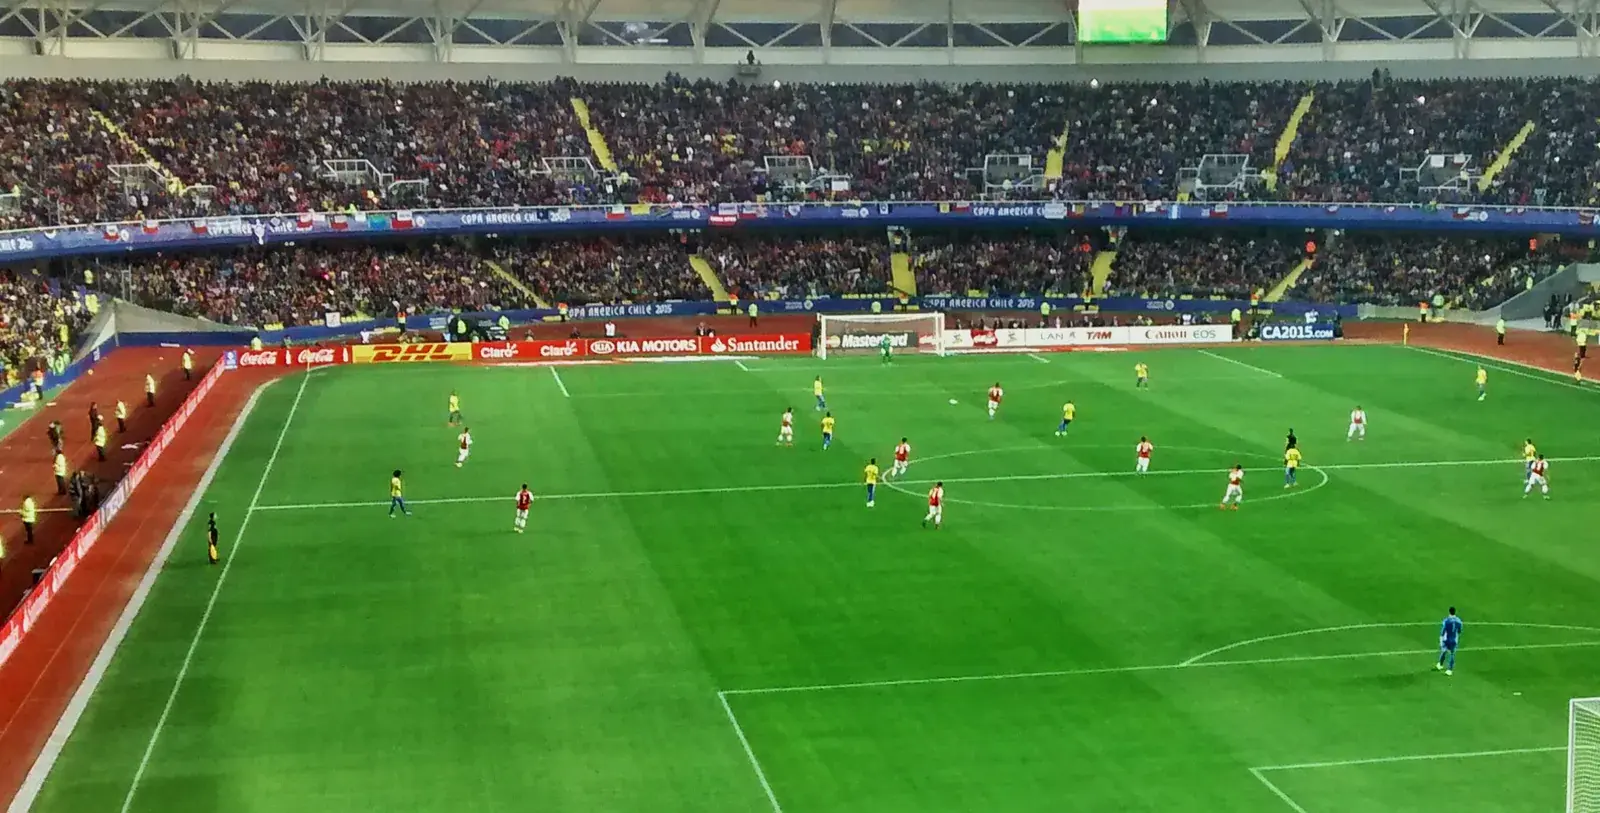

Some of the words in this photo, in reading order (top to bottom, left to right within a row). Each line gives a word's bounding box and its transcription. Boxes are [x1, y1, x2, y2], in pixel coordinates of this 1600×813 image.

[973, 207, 996, 217] COPA
[998, 206, 1034, 217] AMERICA
[461, 213, 484, 225] COPA
[486, 212, 522, 224] AMERICA
[949, 299, 987, 308] AMERICA
[989, 299, 1013, 308] CHILE
[1017, 299, 1036, 308] 2015
[568, 308, 586, 318] OPA
[588, 305, 626, 317] AMERICA
[627, 304, 652, 315] CHILE
[655, 304, 673, 314] 2015
[1086, 331, 1113, 340] TAM
[1145, 329, 1187, 339] Canon
[1193, 329, 1217, 339] EOS
[616, 341, 640, 353] KIA
[642, 339, 697, 352] MOTORS
[727, 335, 800, 352] Santander
[842, 333, 908, 348] Masterard
[373, 344, 452, 361] DHL
[480, 346, 513, 358] Claro
[540, 345, 573, 356] Claro
